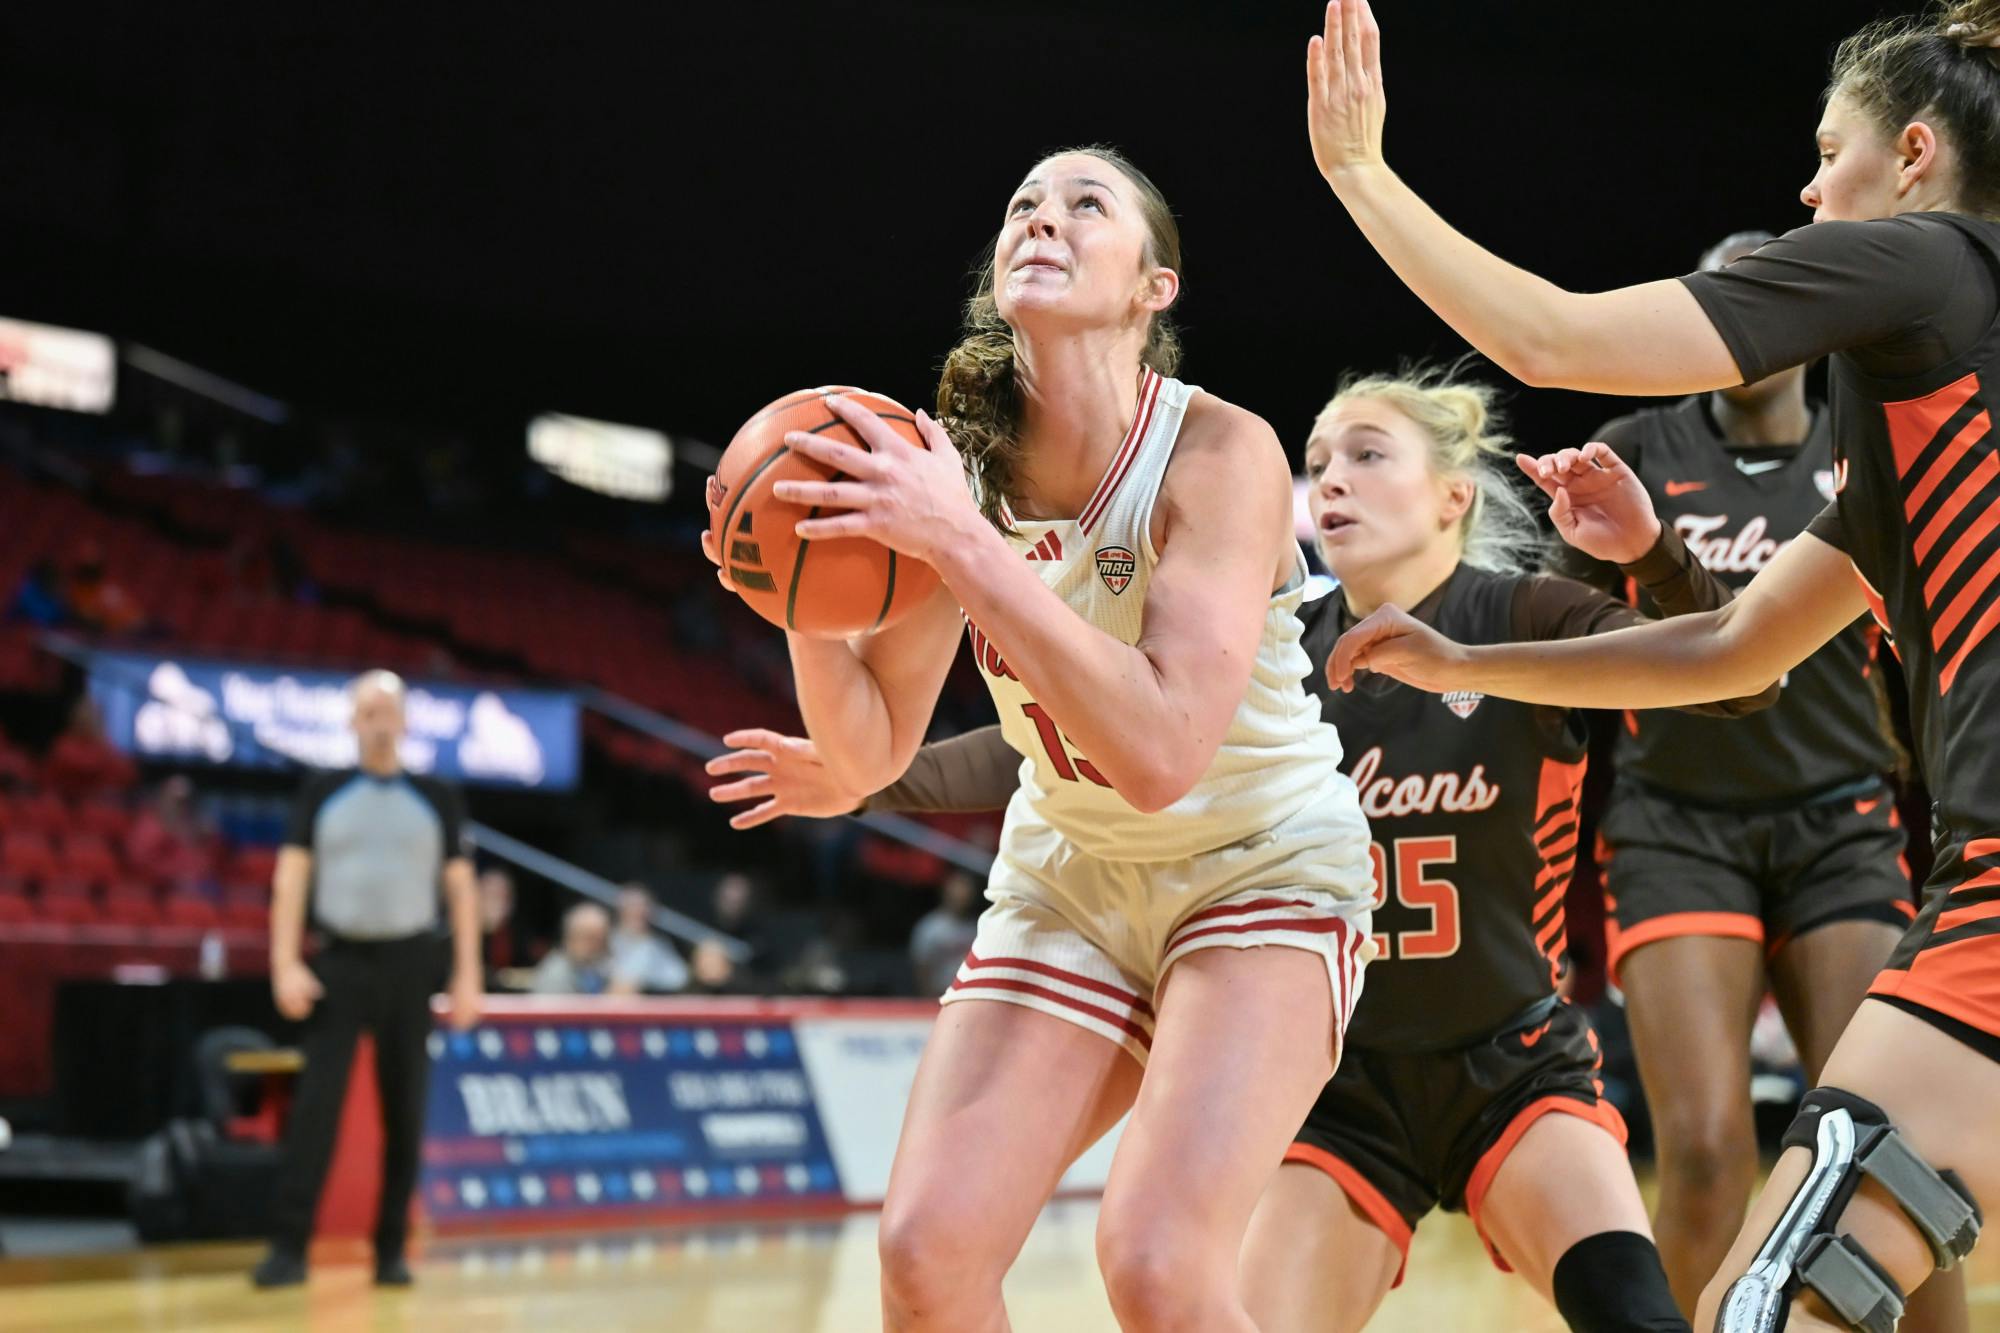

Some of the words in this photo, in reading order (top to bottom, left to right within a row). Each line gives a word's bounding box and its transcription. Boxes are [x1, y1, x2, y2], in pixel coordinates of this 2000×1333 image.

[1098, 561, 1134, 575] MAC
[1674, 514, 1792, 572] Falc
[1351, 747, 1500, 818] lcons
